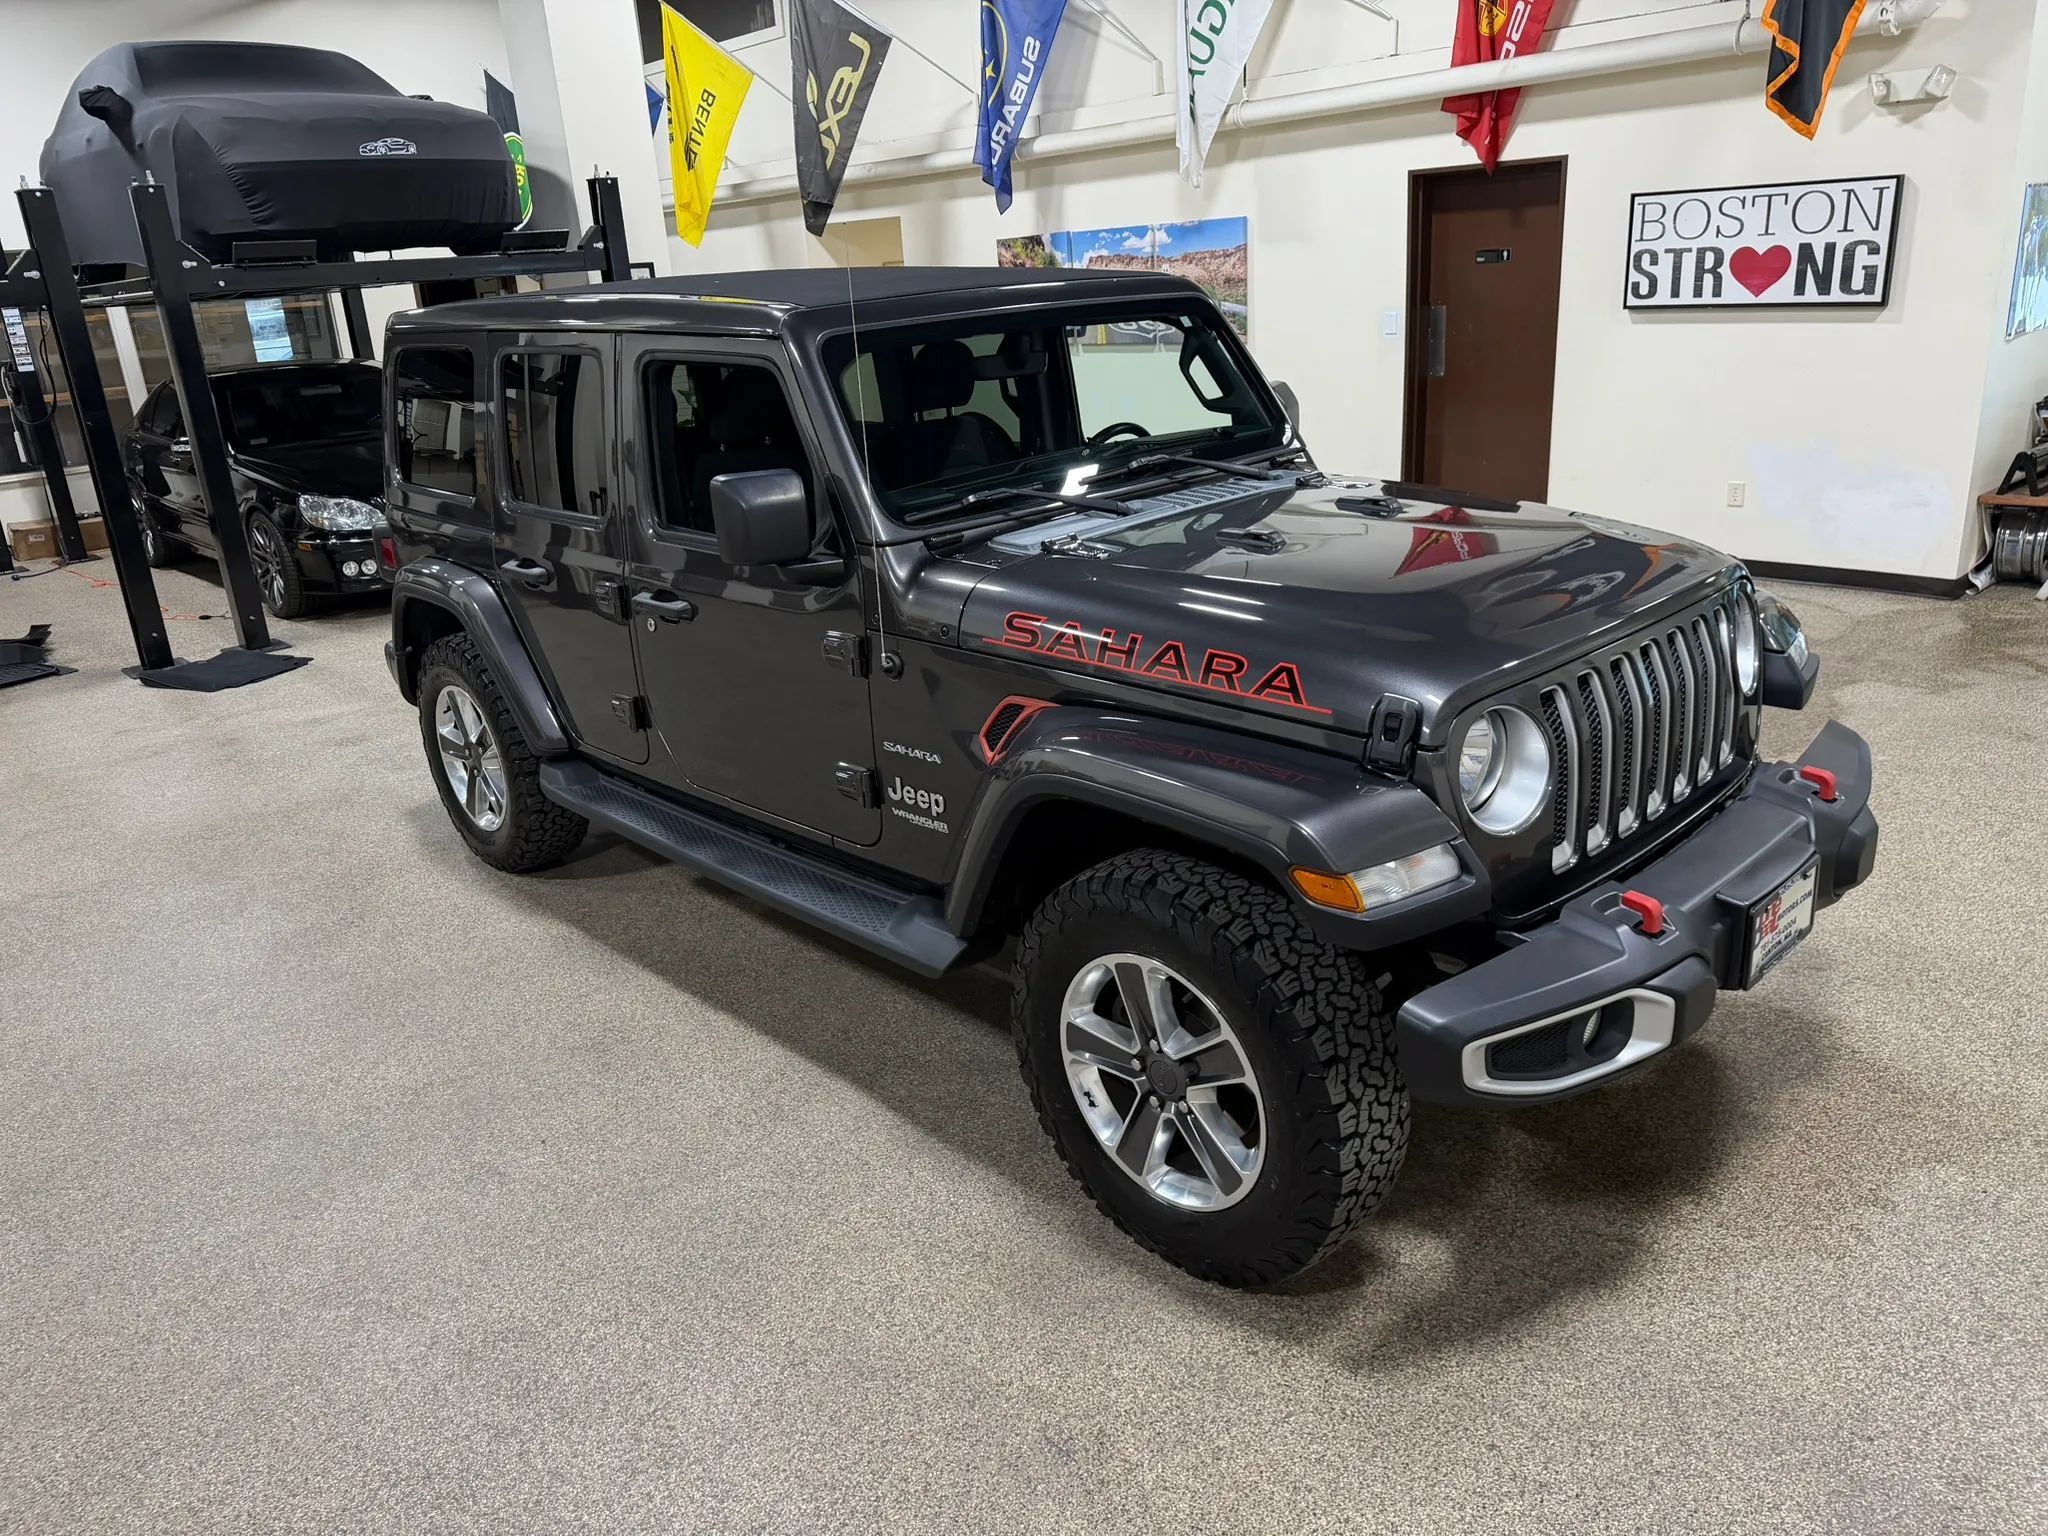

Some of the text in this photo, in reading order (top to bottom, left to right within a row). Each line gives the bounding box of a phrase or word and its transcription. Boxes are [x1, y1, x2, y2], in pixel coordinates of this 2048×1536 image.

[1633, 186, 1891, 243] BOSTON
[1001, 610, 1310, 710] SAHARA
[883, 741, 942, 764] SAHARA
[887, 776, 945, 817] Jeep
[891, 806, 949, 830] WRANGLER
